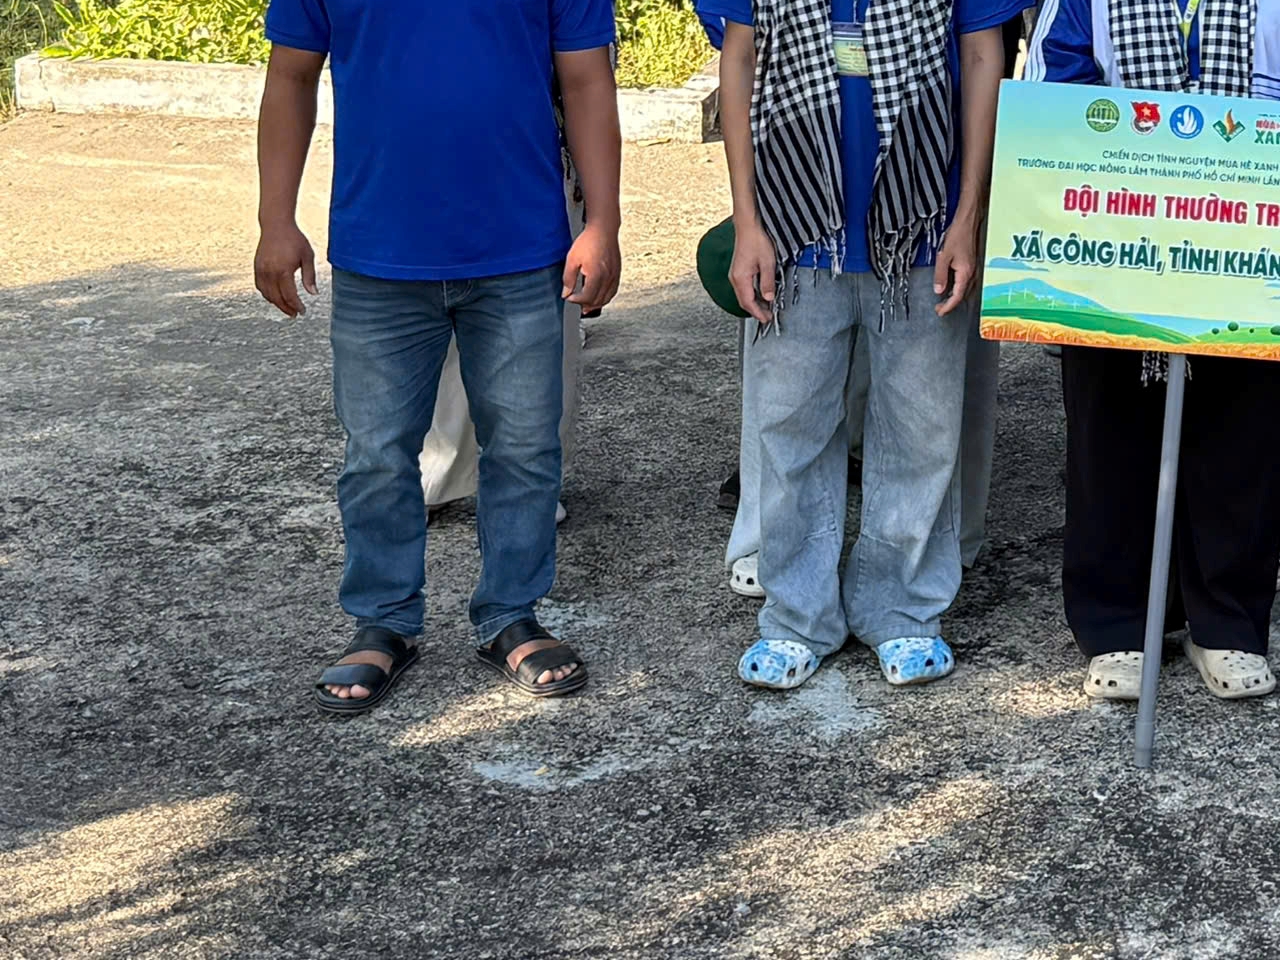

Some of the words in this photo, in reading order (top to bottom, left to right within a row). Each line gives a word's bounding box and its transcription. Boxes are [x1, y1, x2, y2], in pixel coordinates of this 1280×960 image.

[1076, 162, 1098, 173] HỌC
[1099, 162, 1127, 174] NÔNG
[1128, 165, 1148, 176] LÂM
[1237, 174, 1261, 185] MINH
[1132, 152, 1155, 163] DỊCH
[1178, 156, 1216, 168] NGUYỆN
[1254, 161, 1279, 172] XANH
[1063, 184, 1100, 218] ĐỘI
[1105, 187, 1157, 218] HÌNH
[1163, 193, 1248, 225] THƯỜNG
[1011, 230, 1042, 260] XÃ
[1046, 232, 1115, 265] CÔNG
[1119, 236, 1163, 273] HẢI,
[1168, 240, 1220, 273] TỈNH
